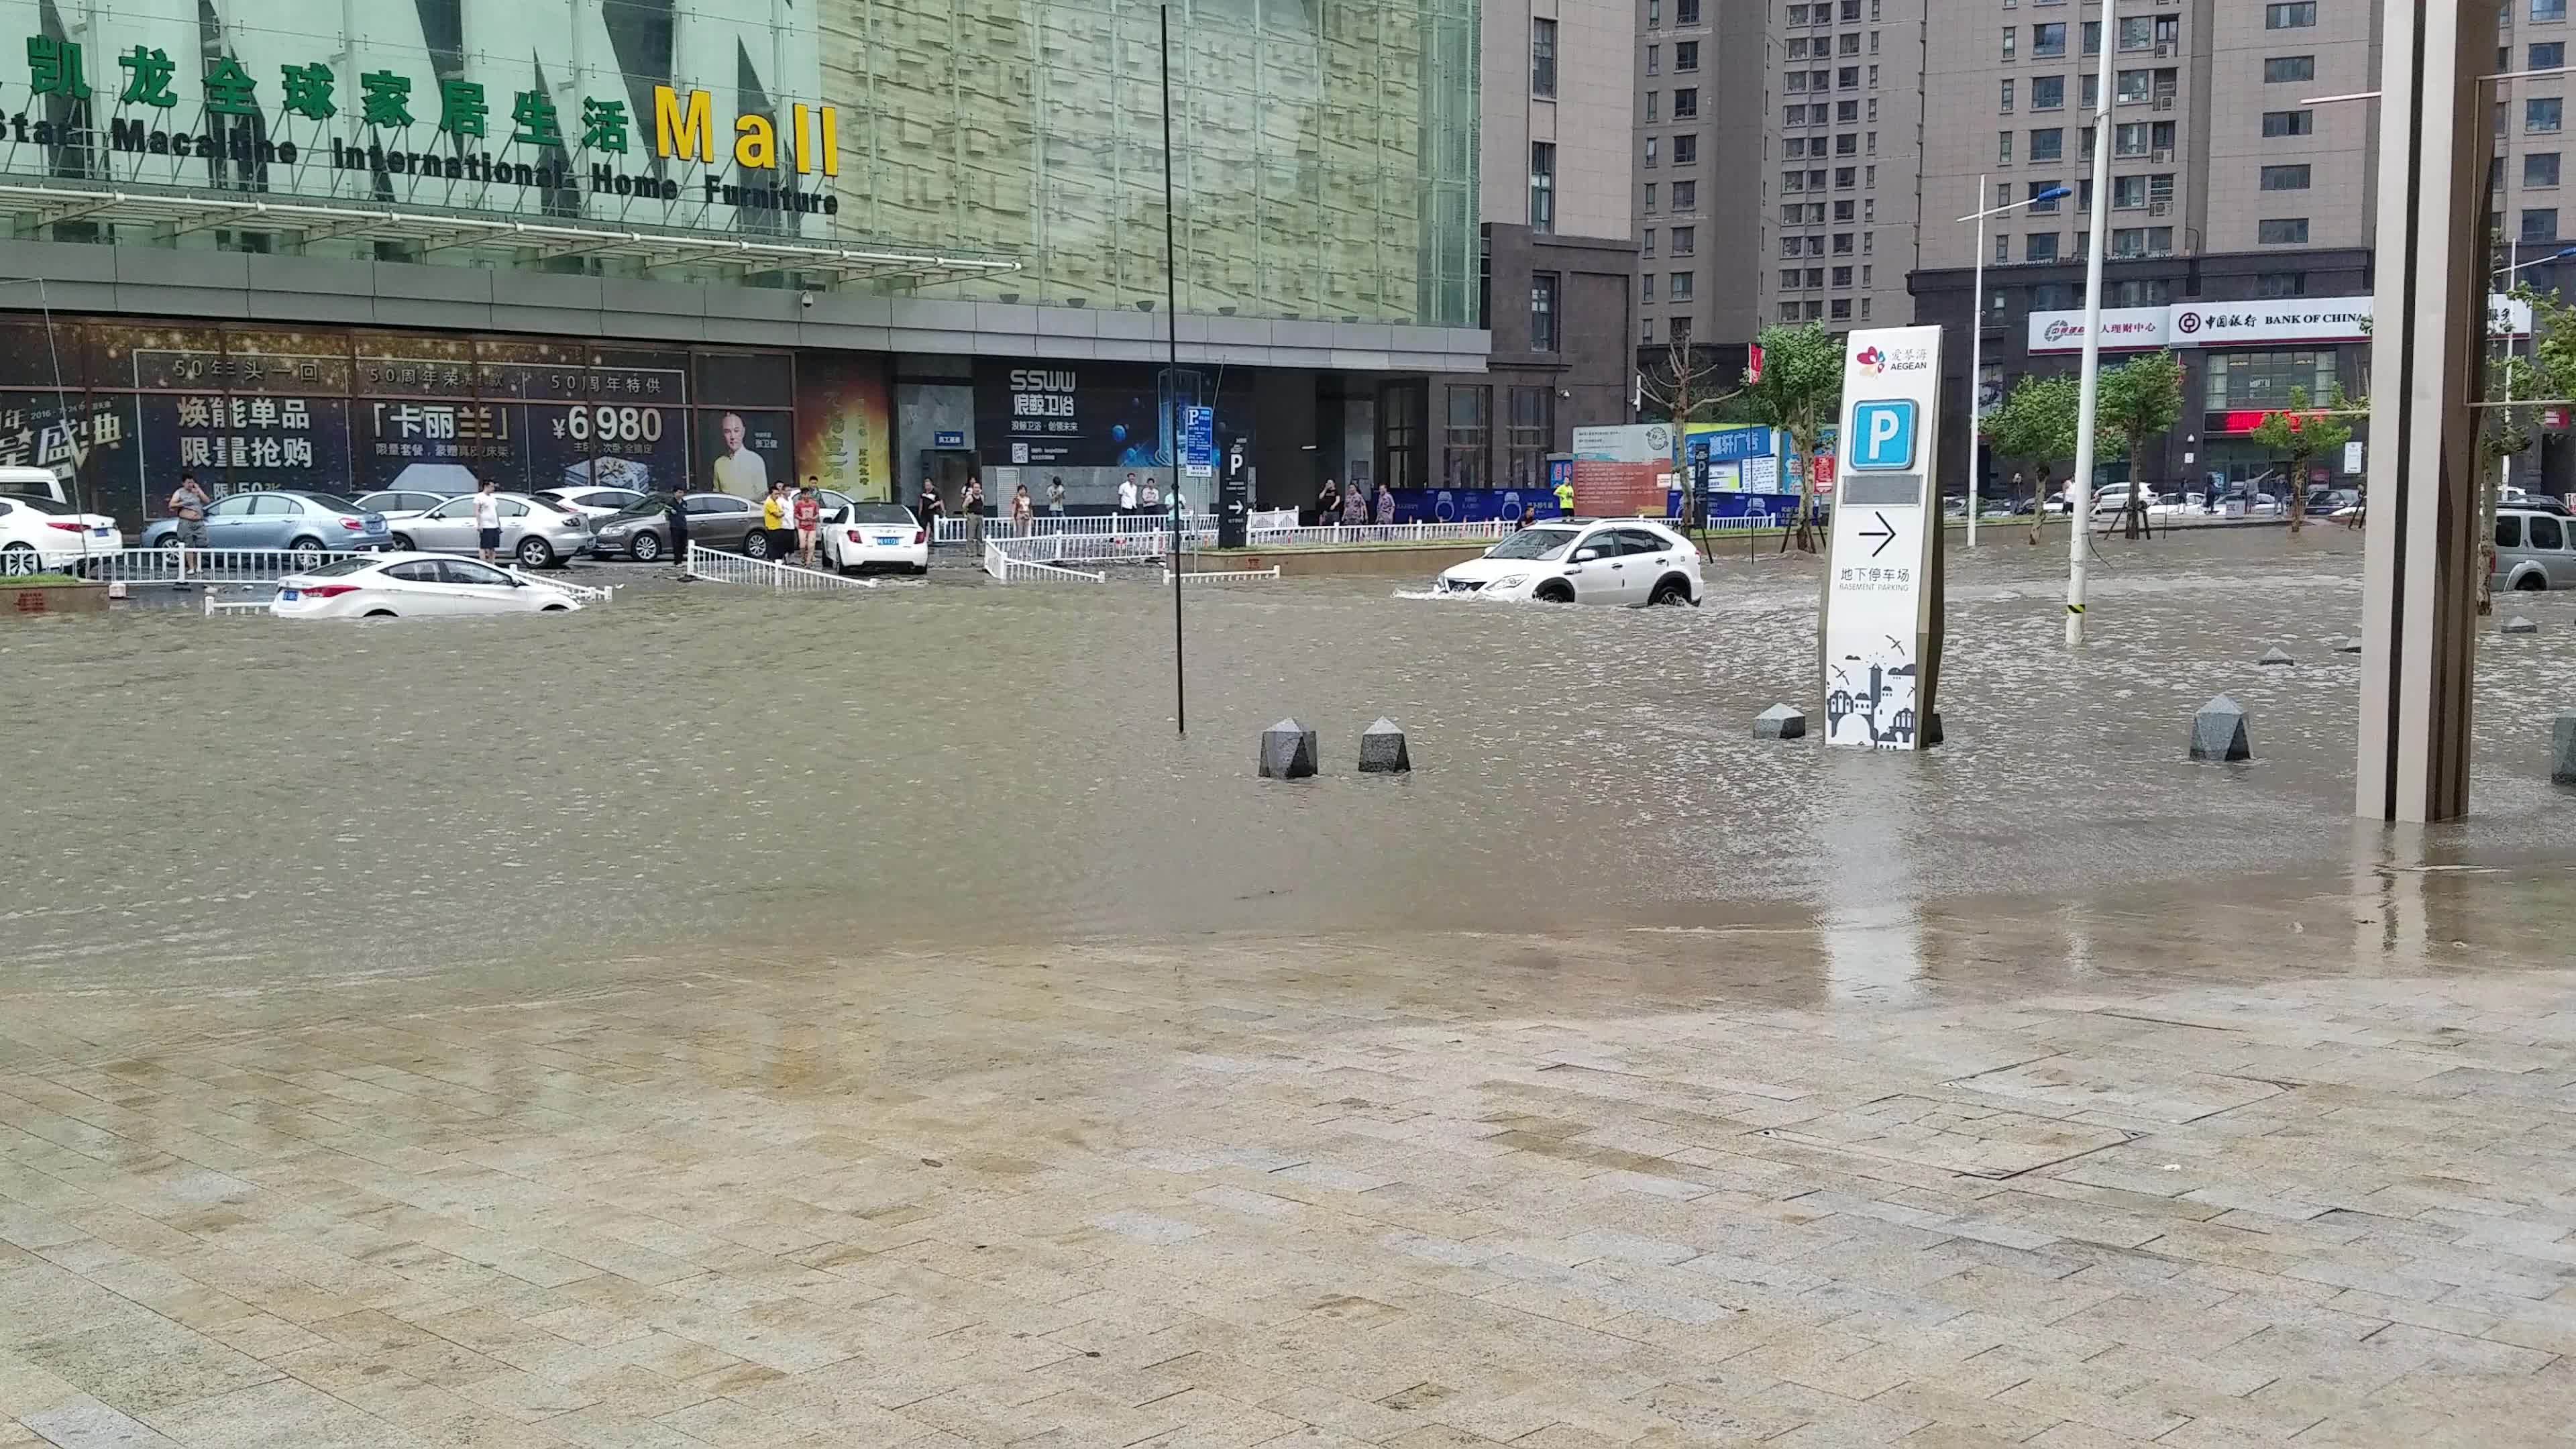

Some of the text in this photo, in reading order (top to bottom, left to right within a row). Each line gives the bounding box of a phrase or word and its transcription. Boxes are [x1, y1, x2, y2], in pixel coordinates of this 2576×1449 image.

[27, 34, 839, 177] 凯龙全球家居生活 Mall
[333, 136, 562, 191] International
[592, 162, 678, 201] Home
[705, 174, 839, 215] Furniture
[2205, 313, 2258, 329] 中国银行
[2265, 314, 2302, 325] BANK
[2303, 314, 2320, 324] OF
[1890, 362, 1927, 371] AEGEAN
[551, 374, 661, 393] 50周年特供
[1010, 369, 1076, 392] SSWW
[177, 396, 311, 429] 焕能单品
[552, 405, 662, 441] ¥6980
[1189, 409, 1199, 426] P
[1868, 410, 1898, 459] P
[180, 437, 313, 468] 限量抢购
[1230, 453, 1243, 476] P
[1840, 567, 1910, 582] 地下停车场
